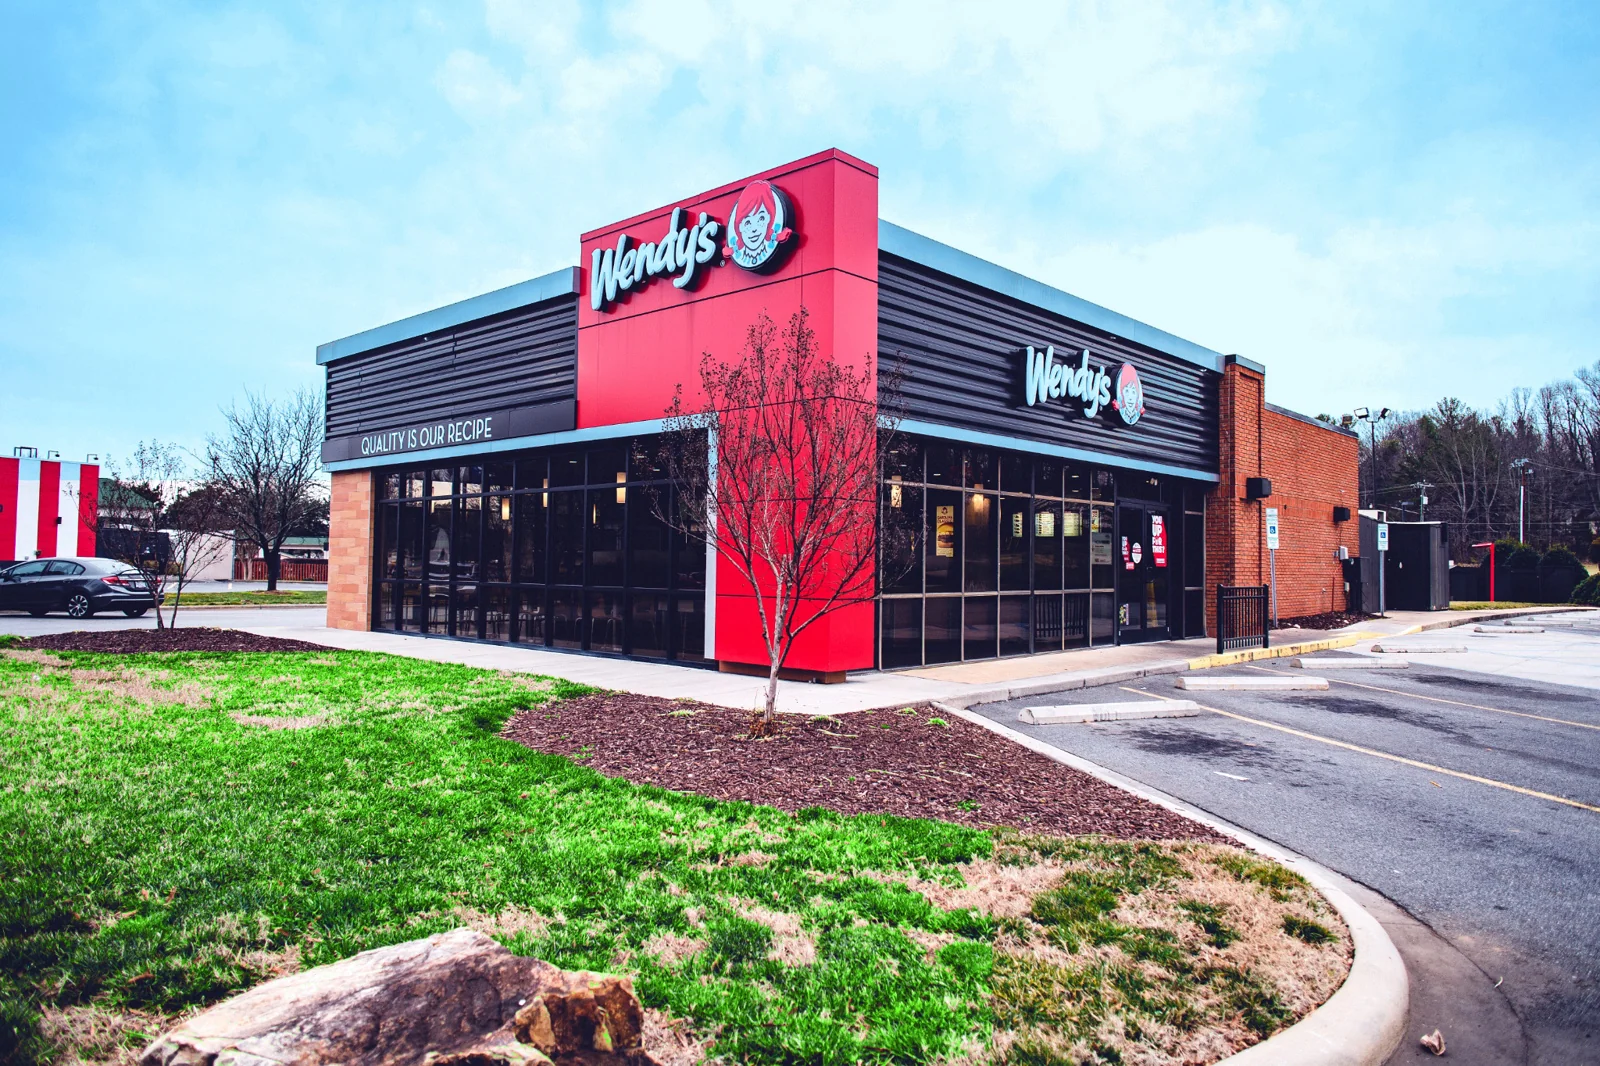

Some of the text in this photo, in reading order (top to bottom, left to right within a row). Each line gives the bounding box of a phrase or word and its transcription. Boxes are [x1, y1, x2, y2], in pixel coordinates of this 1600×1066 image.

[591, 207, 721, 311] Wendy's
[1025, 345, 1111, 419] Wendy's
[361, 417, 493, 455] QUALITY IS OUR RECIPE
